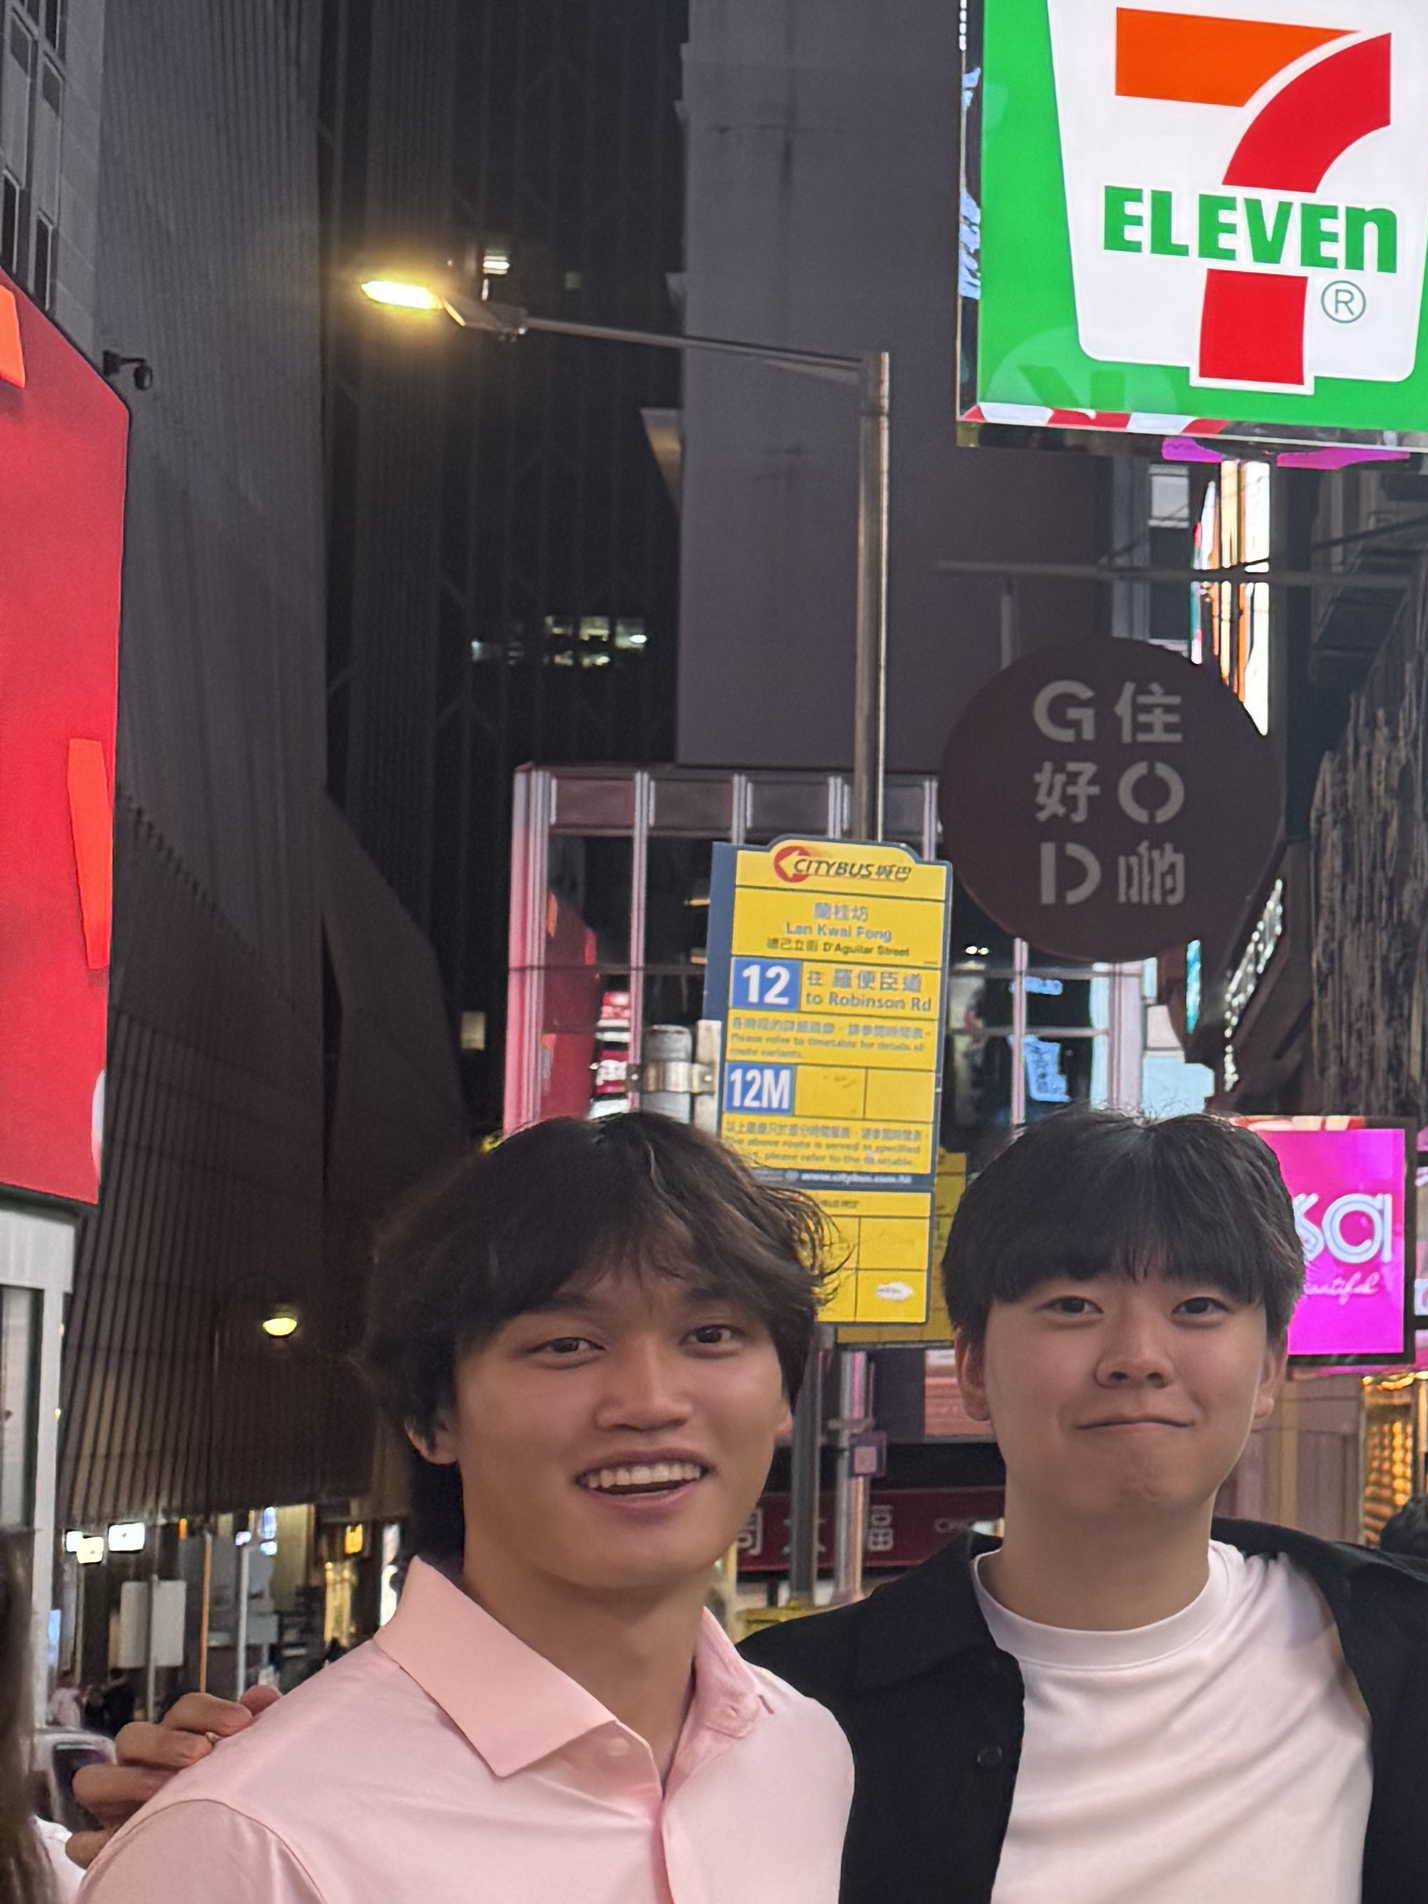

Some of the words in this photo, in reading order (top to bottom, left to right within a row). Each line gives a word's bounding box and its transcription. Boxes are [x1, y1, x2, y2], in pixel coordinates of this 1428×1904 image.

[793, 858, 872, 879] CITYBUS
[785, 922, 812, 935] Lan
[817, 924, 852, 937] Kwai
[856, 926, 892, 943] Fong
[877, 946, 910, 957] Street
[742, 964, 790, 1005] 12
[806, 992, 823, 1005] to
[829, 993, 905, 1009] Robinson
[911, 997, 932, 1012] Rd
[730, 1068, 791, 1110] 12M
